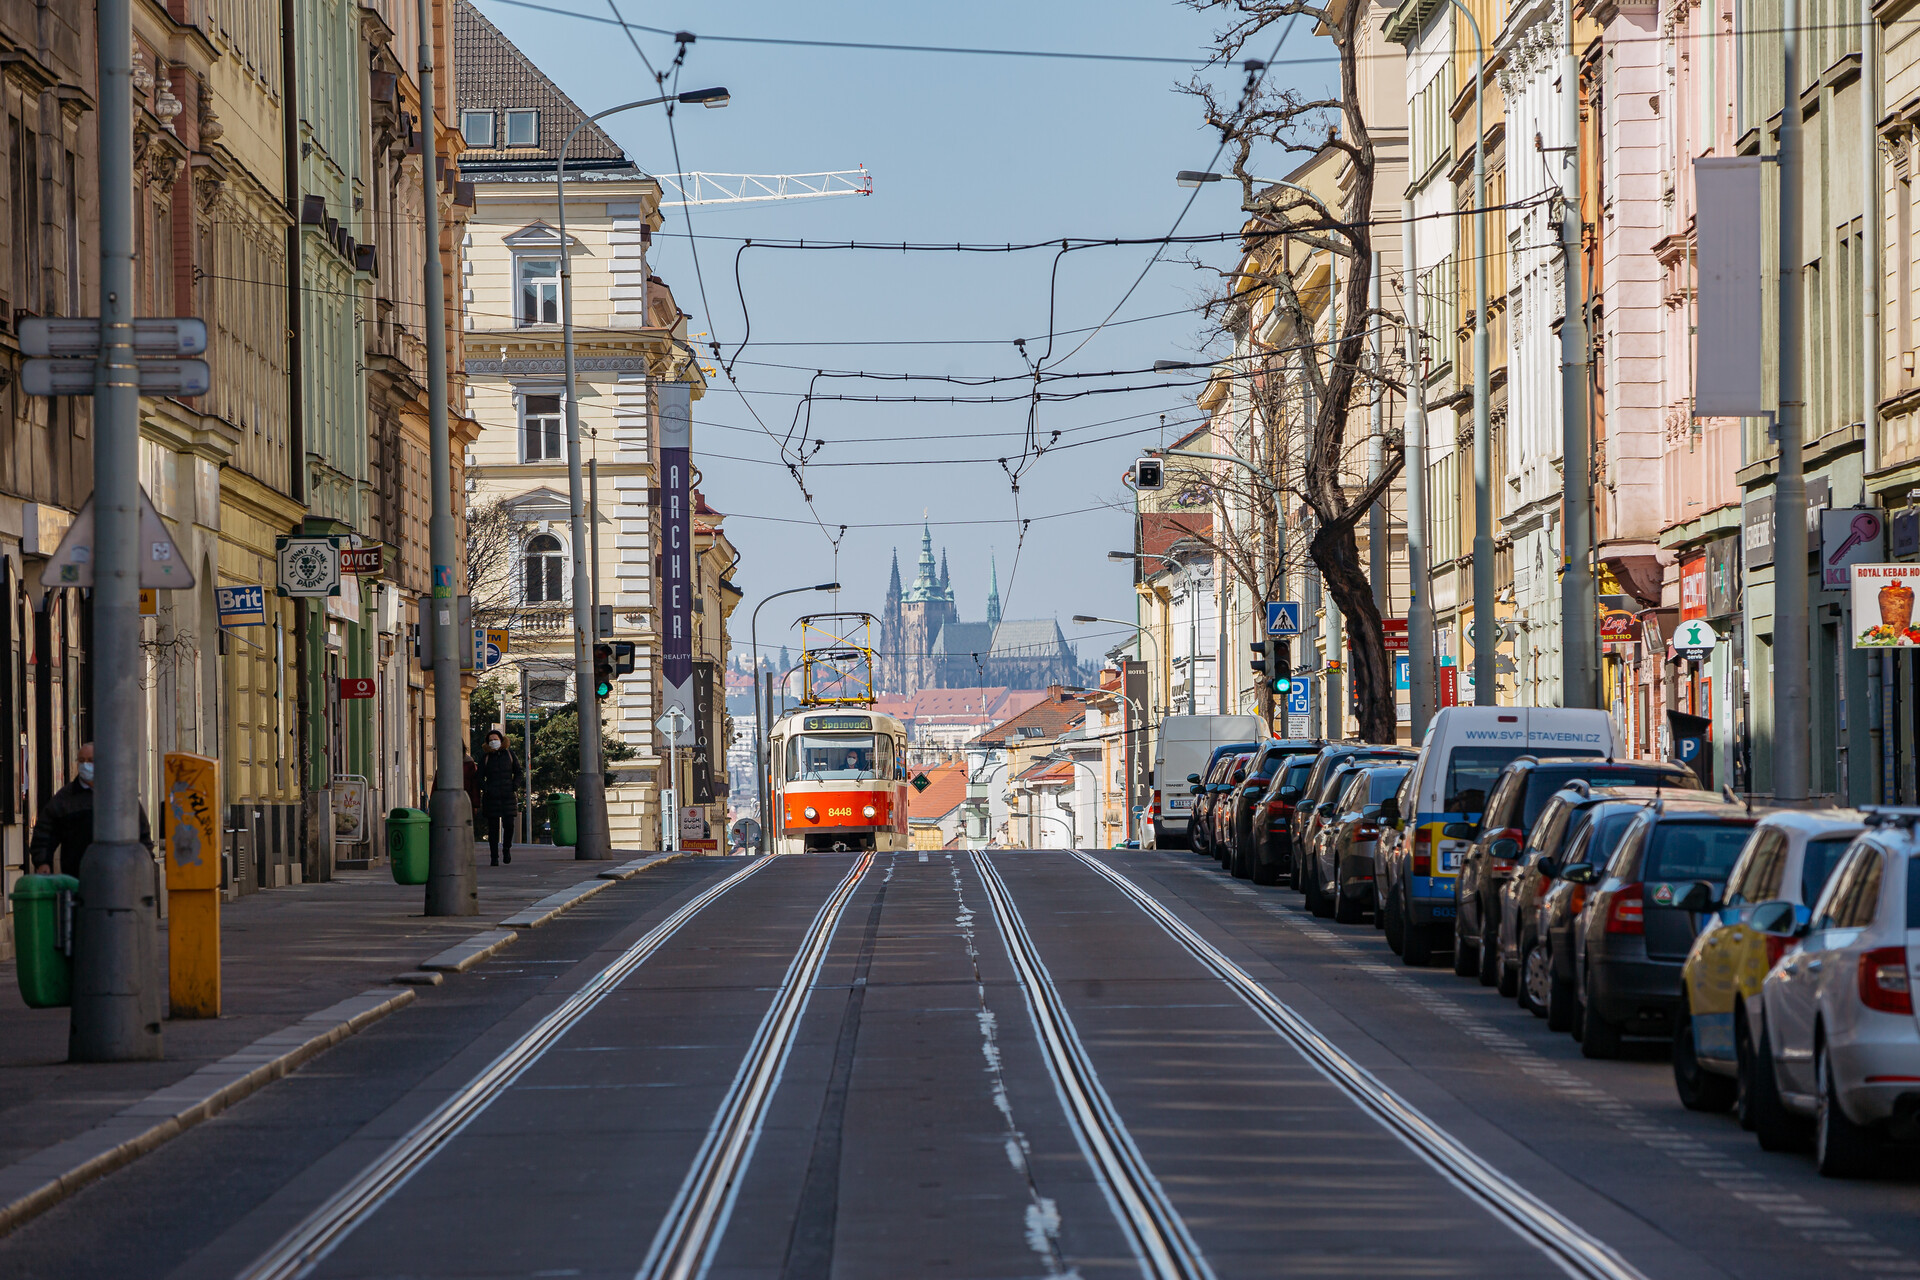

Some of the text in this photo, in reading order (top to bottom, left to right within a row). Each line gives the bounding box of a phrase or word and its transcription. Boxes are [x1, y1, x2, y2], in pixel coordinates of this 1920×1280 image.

[289, 545, 328, 565] VINNÝ ŠENK
[670, 465, 682, 639] ARCHER
[1858, 568, 1881, 577] ROYAL
[1883, 568, 1908, 577] KEBAB
[218, 588, 262, 609] Brit
[1602, 616, 1628, 634] Long
[475, 630, 484, 670] OPEN
[1290, 682, 1305, 703] P
[698, 669, 709, 797] VICTORIA
[810, 718, 818, 730] 9
[1466, 730, 1600, 743] WWW.SVP-STAVEBNI.CZ
[1683, 740, 1695, 757] P
[828, 808, 852, 816] 8448
[683, 840, 716, 849] Restaurant
